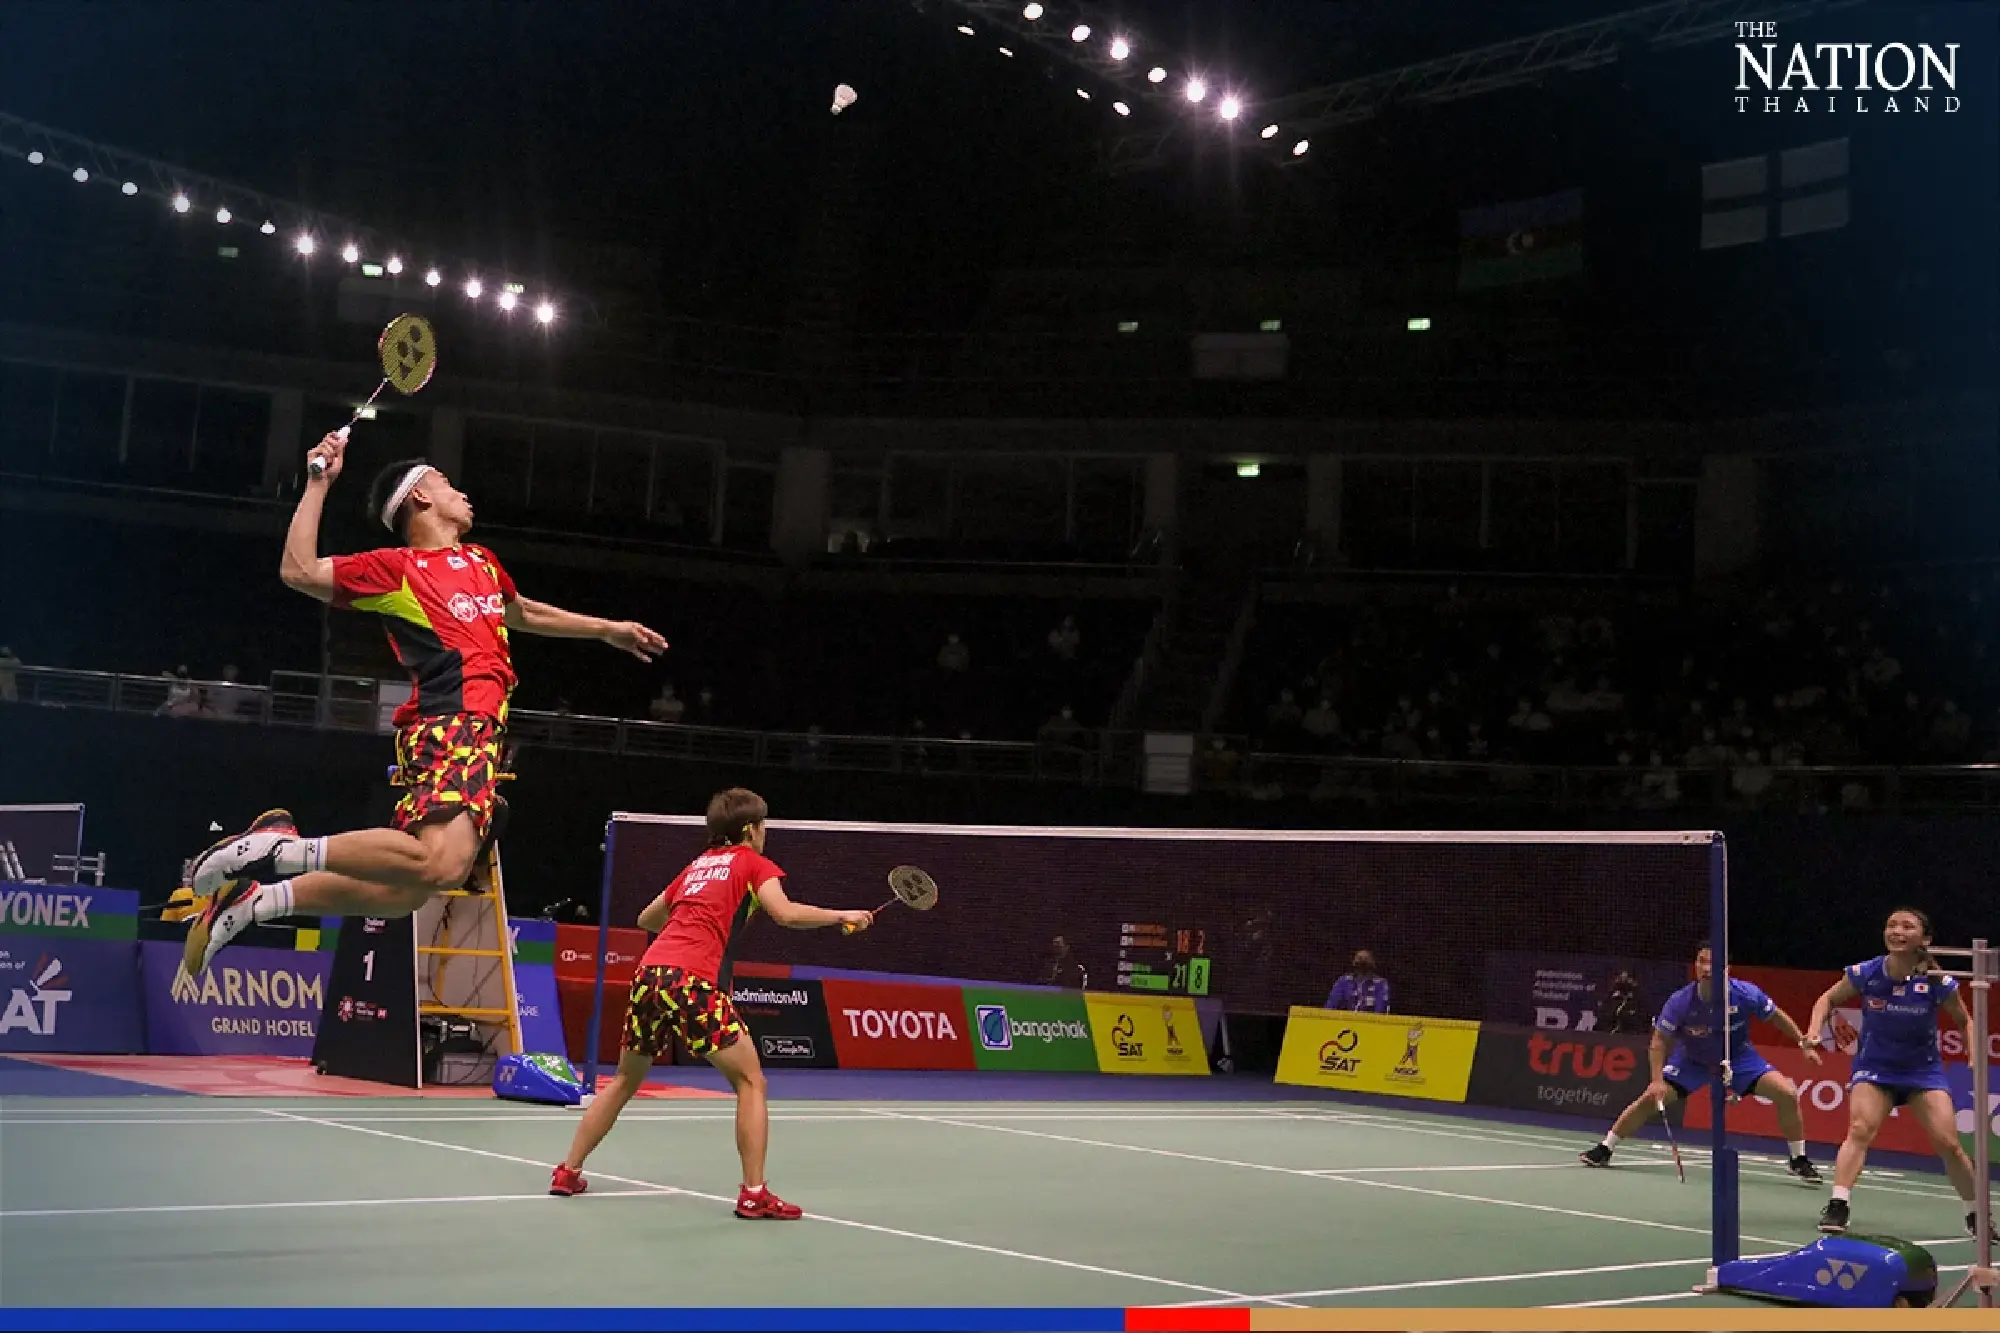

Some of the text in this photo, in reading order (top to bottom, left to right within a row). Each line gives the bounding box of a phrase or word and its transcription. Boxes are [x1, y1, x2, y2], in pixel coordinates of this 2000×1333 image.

[362, 950, 375, 981] 1
[211, 1015, 316, 1037] GRAND HOTEL
[843, 1009, 958, 1041] TOYOTA
[1010, 1018, 1089, 1044] bangchak
[1118, 1042, 1143, 1056] SAT
[1527, 1031, 1637, 1082] true
[1319, 1055, 1362, 1073] SAT
[1537, 1085, 1610, 1106] together
